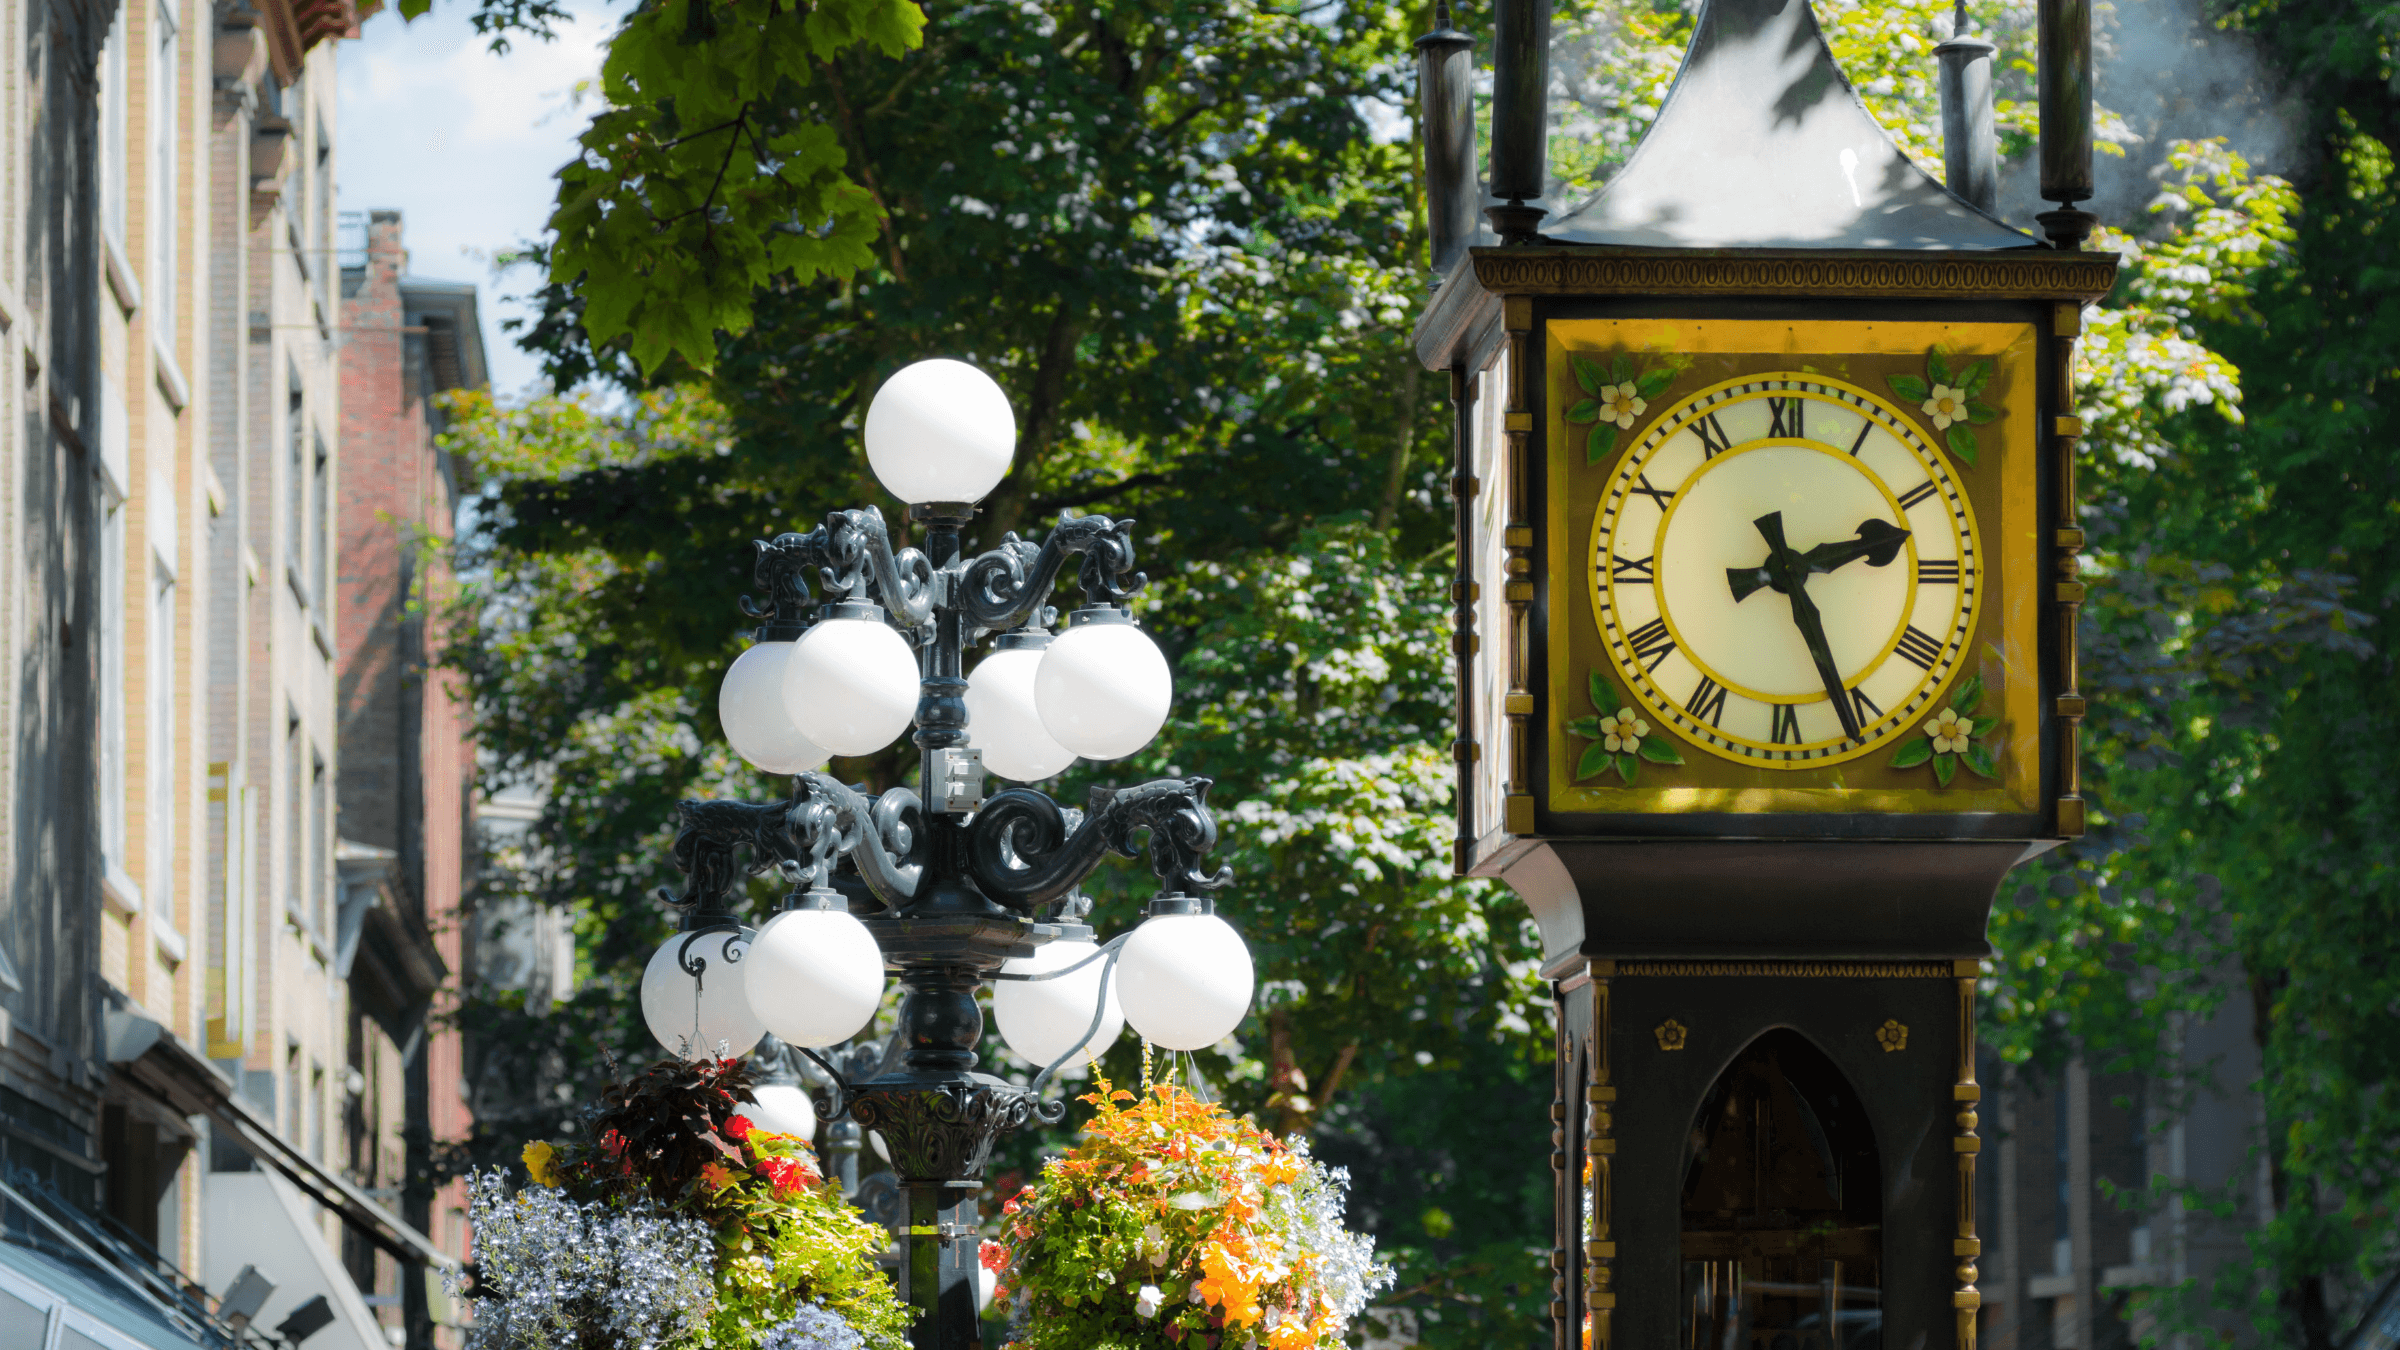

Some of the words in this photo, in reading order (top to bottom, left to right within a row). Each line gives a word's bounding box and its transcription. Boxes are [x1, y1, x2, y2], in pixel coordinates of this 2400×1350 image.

[1688, 411, 1731, 460] XI
[1768, 397, 1804, 438] XII
[1850, 419, 1874, 456] I
[1630, 472, 1676, 512] X
[1898, 479, 1937, 511] II
[1612, 554, 1654, 584] IX
[1918, 559, 1959, 584] III
[1628, 617, 1677, 673] VIII
[1893, 624, 1945, 671] IIII
[1684, 674, 1728, 727] VII
[1850, 687, 1884, 727] V
[1771, 703, 1801, 744] VI
